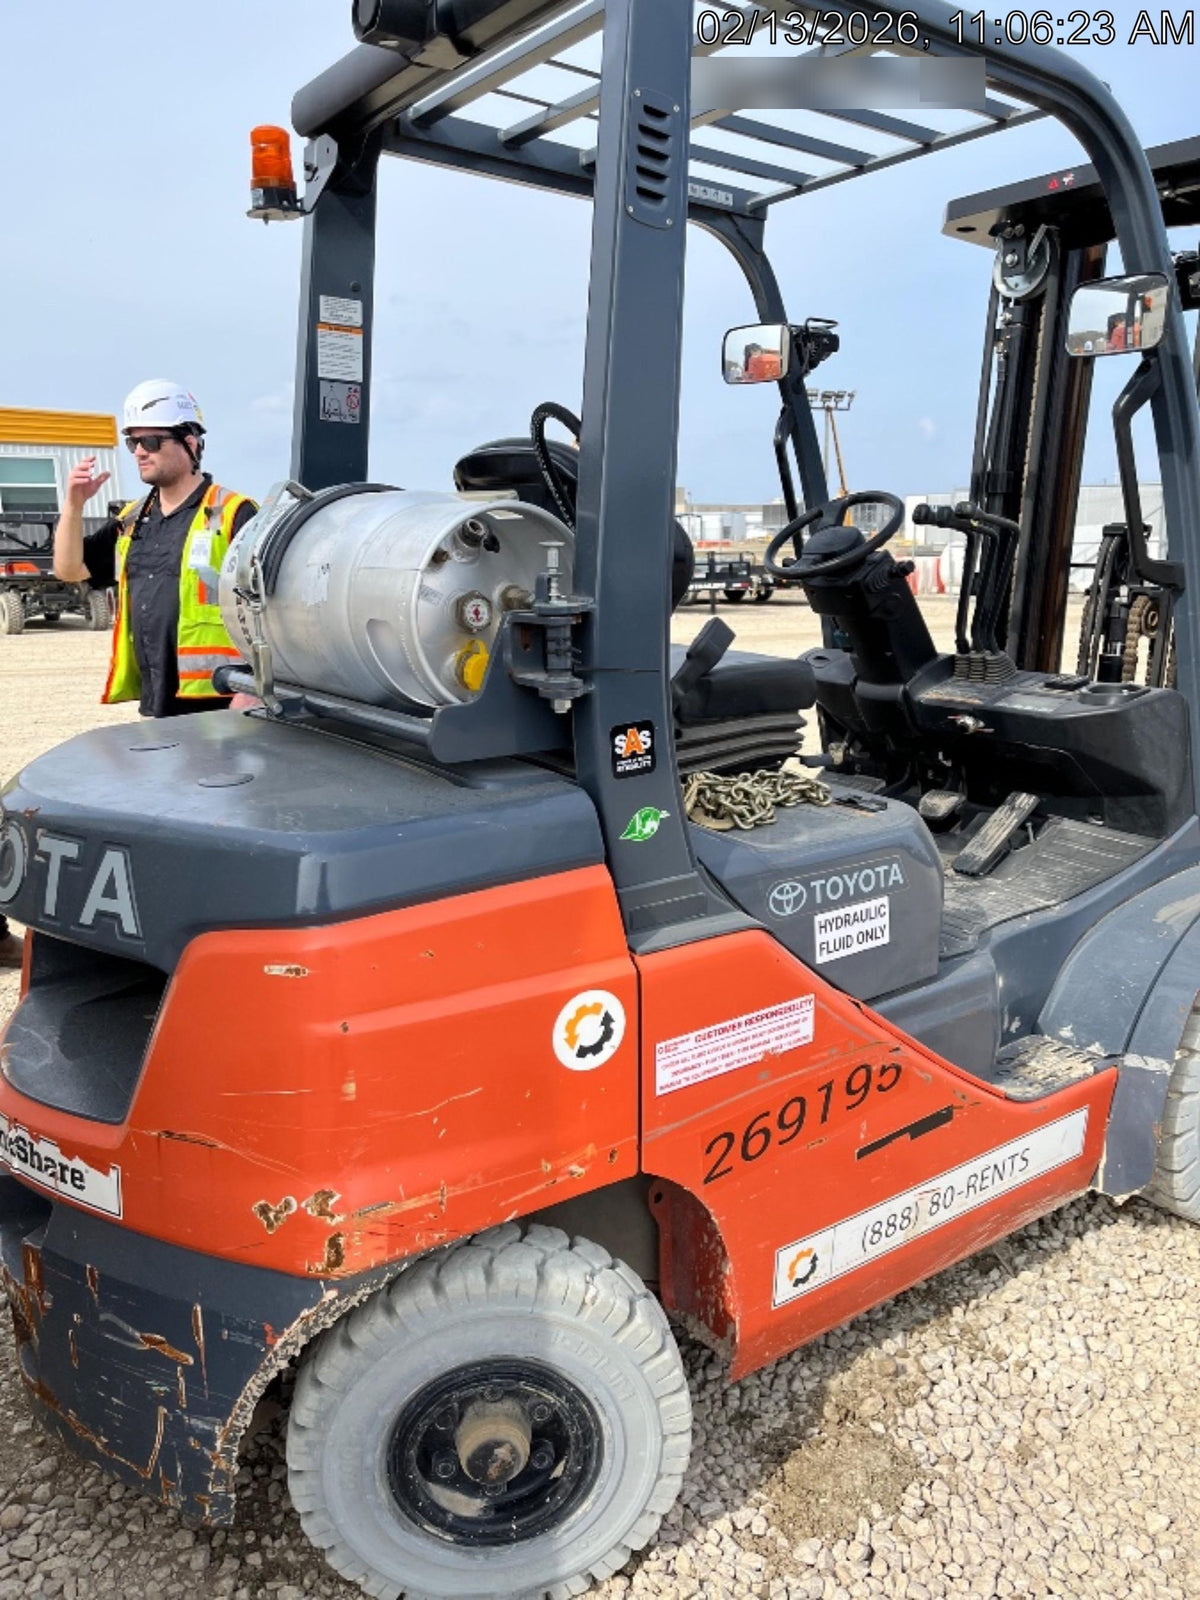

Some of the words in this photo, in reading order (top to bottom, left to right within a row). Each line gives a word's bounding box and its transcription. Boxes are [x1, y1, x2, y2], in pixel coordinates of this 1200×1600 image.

[614, 727, 652, 757] SAS
[810, 863, 903, 904] TOYOTA
[818, 904, 887, 935] HYDRAULIC
[819, 934, 855, 958] FLUID
[856, 924, 887, 946] ONLY
[703, 1047, 902, 1185] 269195
[861, 1201, 920, 1252] (888)
[928, 1148, 1031, 1217] 80-RENTS
